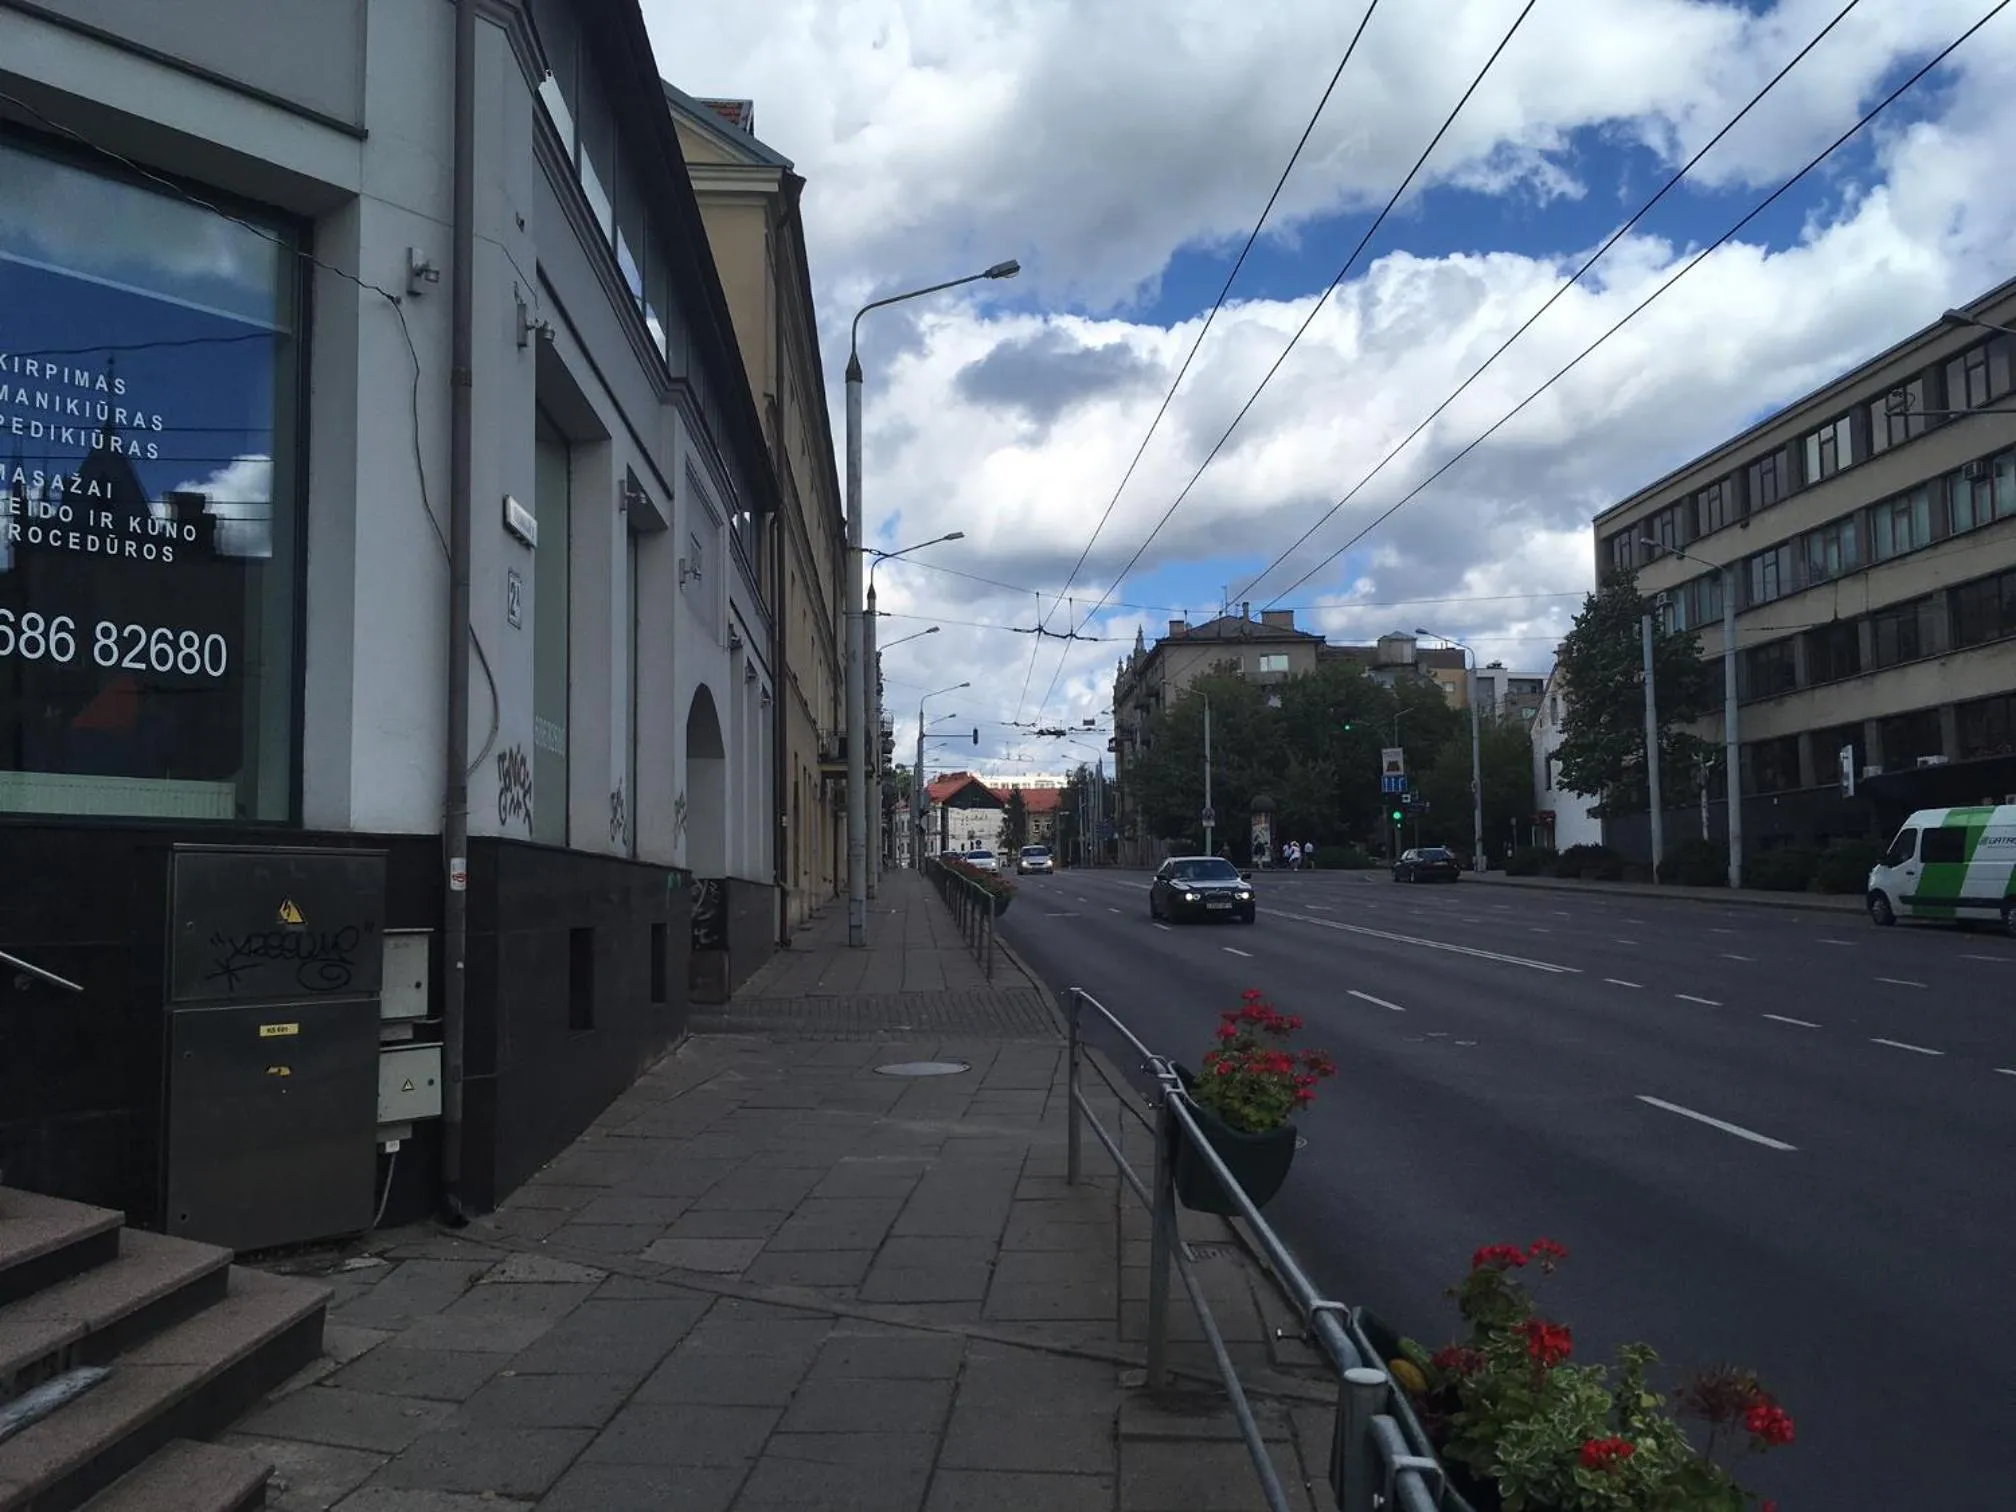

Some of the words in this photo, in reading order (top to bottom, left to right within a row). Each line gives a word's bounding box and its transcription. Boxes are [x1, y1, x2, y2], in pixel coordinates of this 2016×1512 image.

[0, 353, 126, 395] KIRPIMAS
[89, 510, 113, 529] IR
[8, 523, 173, 562] ROCEDŪROS
[0, 608, 75, 662] 686
[93, 620, 227, 677] 82680
